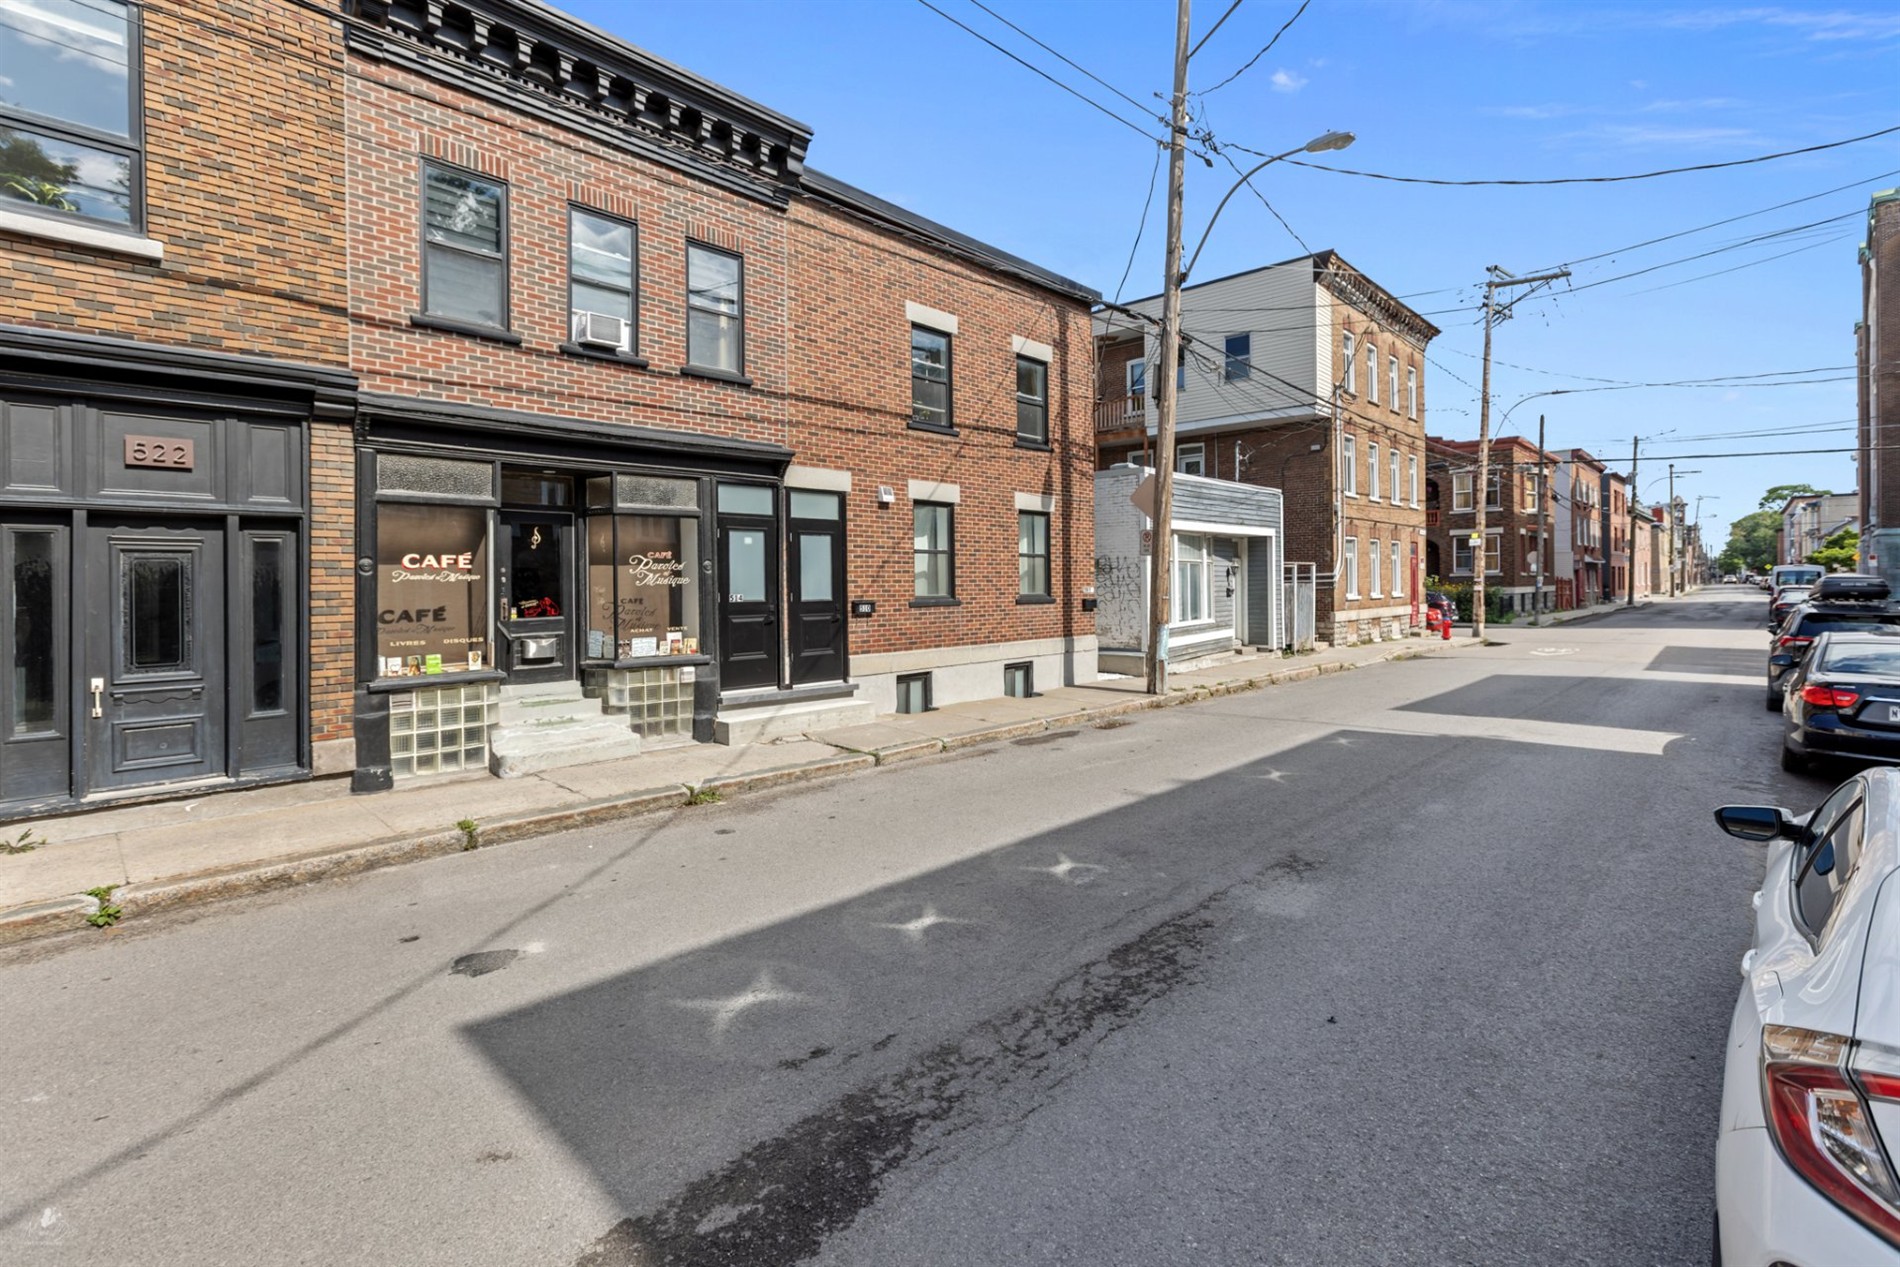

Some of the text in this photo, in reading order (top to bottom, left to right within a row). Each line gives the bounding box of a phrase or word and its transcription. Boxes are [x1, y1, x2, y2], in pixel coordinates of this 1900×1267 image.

[133, 440, 188, 465] 522
[401, 552, 473, 570] CAFÉ
[647, 551, 673, 559] CAFÉ
[629, 554, 687, 574] Paroles
[635, 570, 690, 587] Musique
[443, 636, 484, 645] DISQUES
